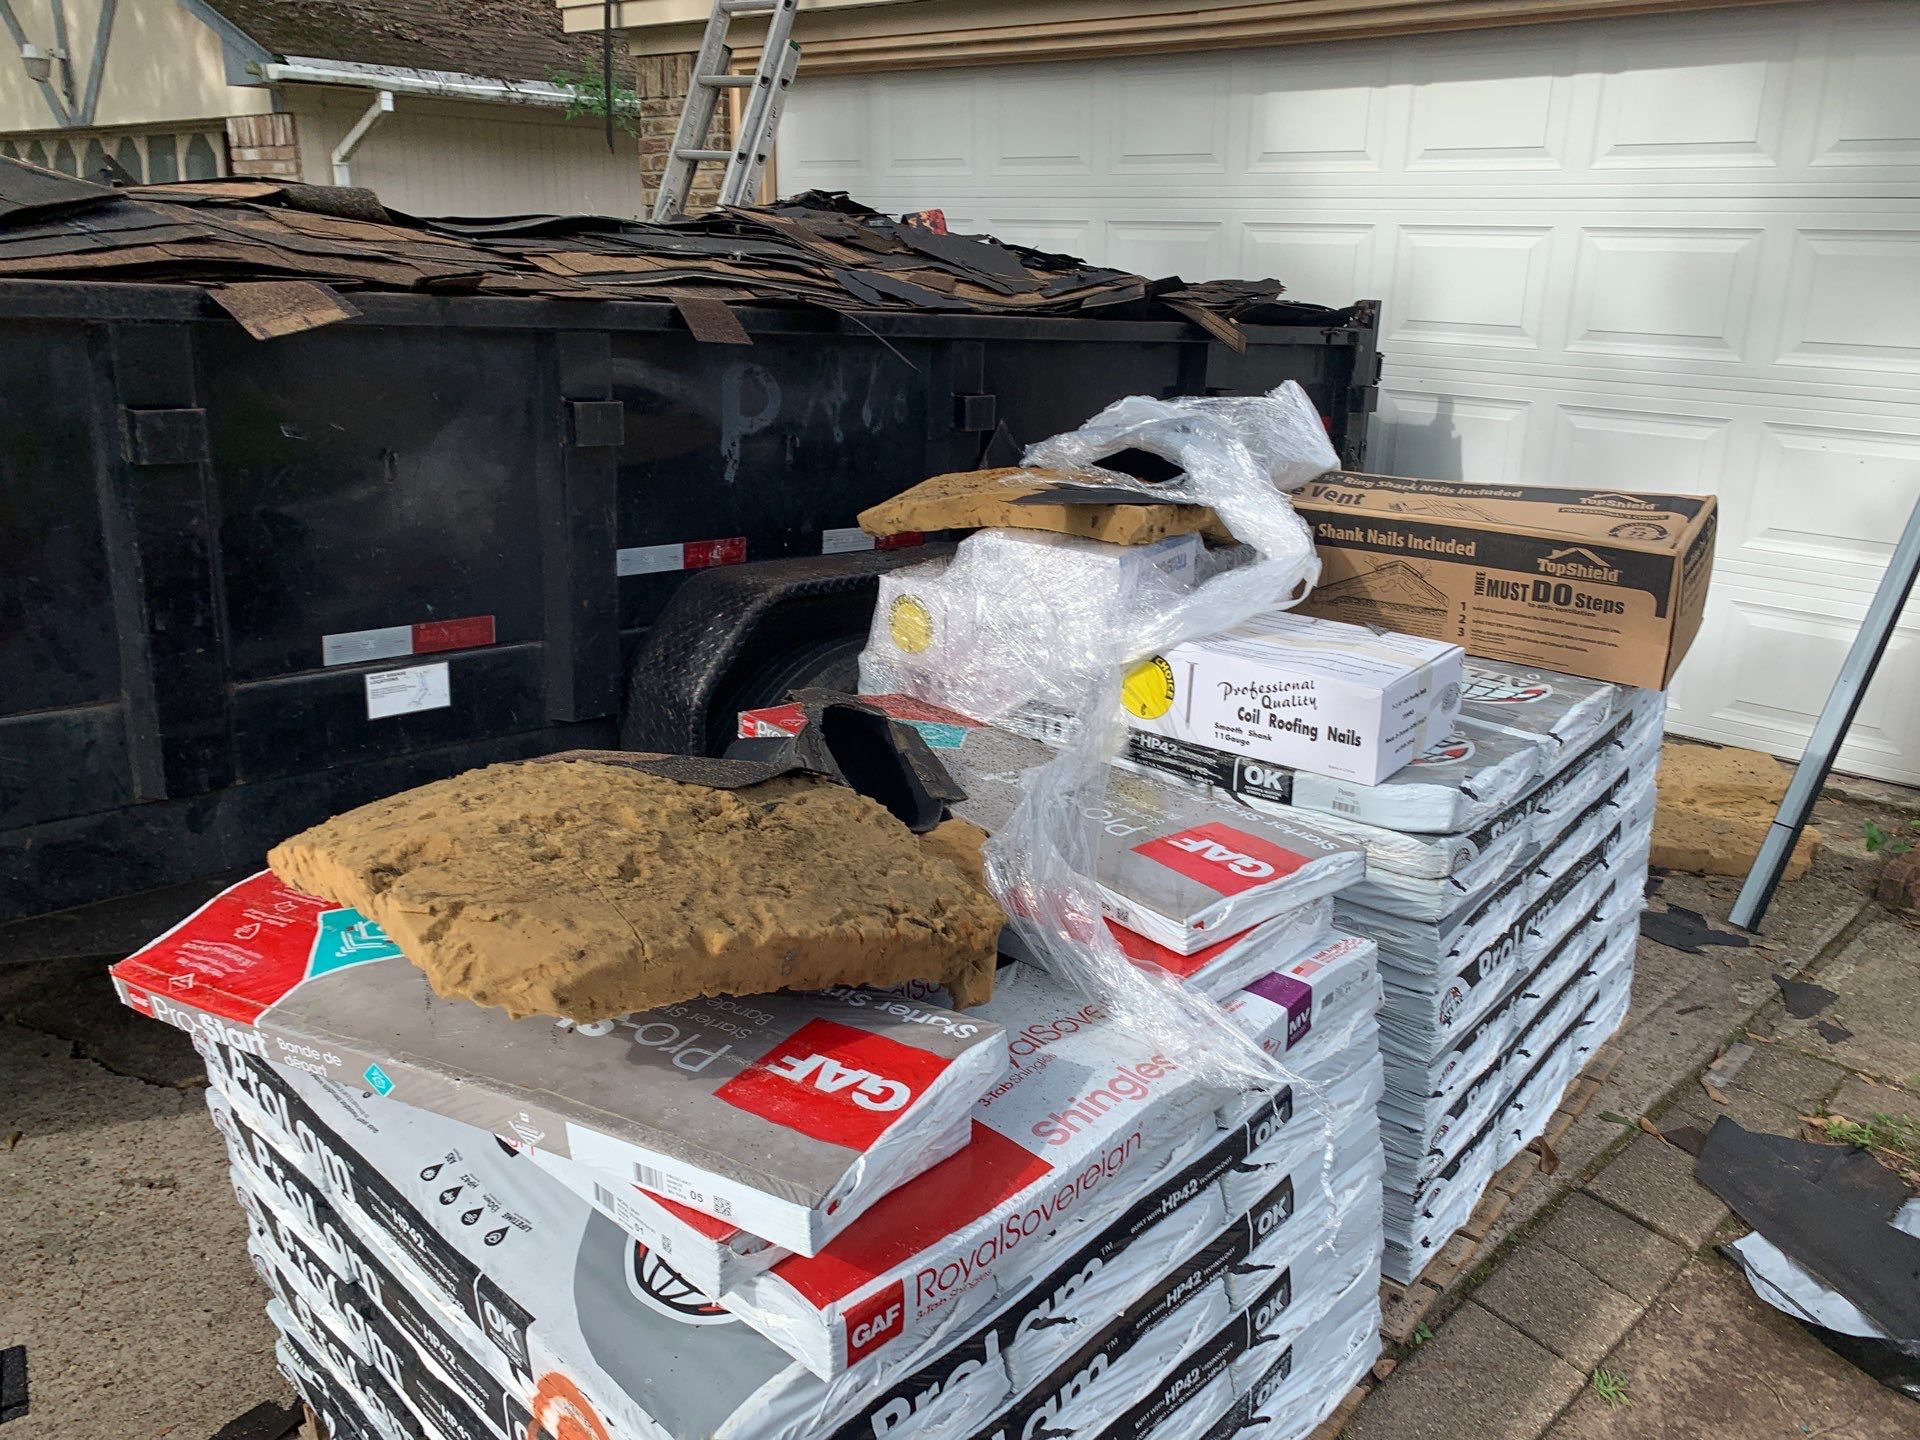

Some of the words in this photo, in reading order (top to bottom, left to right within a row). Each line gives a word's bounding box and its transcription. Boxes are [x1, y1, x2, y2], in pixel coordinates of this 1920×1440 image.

[1311, 485, 1366, 506] Vent
[1343, 476, 1374, 489] Ring
[1419, 484, 1455, 495] Nails
[1457, 487, 1523, 499] Included
[1579, 496, 1659, 511] TopShield
[1318, 523, 1364, 543] Shank
[1367, 528, 1405, 548] Nails
[1407, 533, 1477, 558] Included
[1474, 571, 1486, 596] THREE
[1537, 557, 1622, 583] TopShield
[1486, 578, 1530, 602] MUST
[1532, 580, 1573, 607] DO
[1575, 592, 1625, 615] Steps
[1155, 656, 1174, 700] CHOICE
[1217, 680, 1315, 701] Professional
[1261, 695, 1318, 710] Quality
[1214, 722, 1243, 735] Smooth
[1248, 728, 1273, 743] Shank
[1237, 707, 1260, 725] Coil
[1269, 713, 1318, 741] Roofing
[1327, 725, 1361, 748] Nails
[1244, 765, 1283, 791] OK
[1268, 820, 1341, 851] Starter
[1166, 837, 1275, 878] GAF
[686, 1013, 752, 1039] Starter
[875, 1000, 978, 1039] Starter
[1289, 1007, 1311, 1036] MV
[276, 1036, 321, 1060] Bande
[322, 1051, 343, 1067] de
[765, 1053, 910, 1112] GAF
[978, 1081, 1013, 1108] 3-Tab
[1009, 1052, 1057, 1087] Shingles
[1031, 1052, 1177, 1146] Shingles
[690, 1190, 704, 1203] 05
[1161, 1178, 1199, 1213] HP42
[501, 1212, 533, 1233] LIFETIME
[916, 1129, 1143, 1307] RoyalSovereign
[1257, 1195, 1287, 1235] OK
[1166, 1270, 1202, 1308] HP42
[484, 1300, 522, 1355] OK
[851, 1302, 901, 1348] GAF
[1255, 1289, 1285, 1331] OK
[1164, 1367, 1201, 1406] HP42
